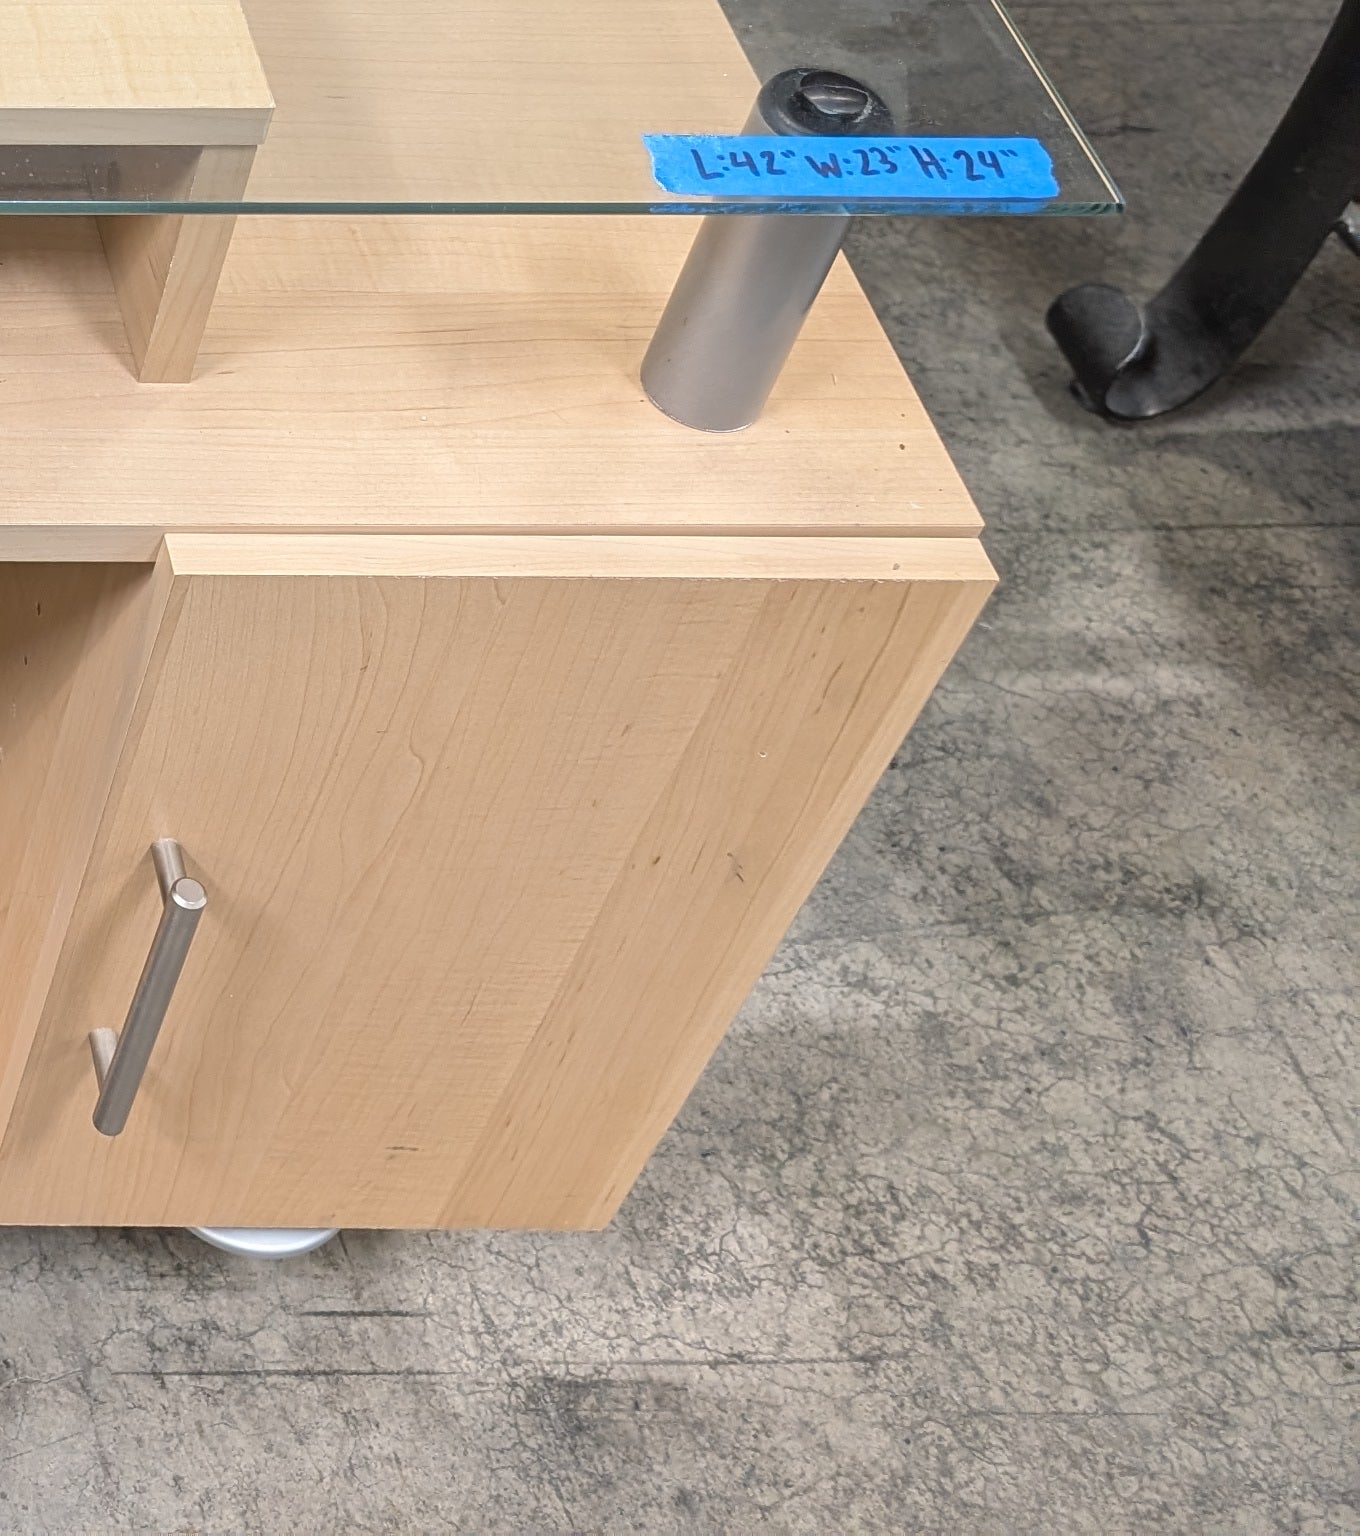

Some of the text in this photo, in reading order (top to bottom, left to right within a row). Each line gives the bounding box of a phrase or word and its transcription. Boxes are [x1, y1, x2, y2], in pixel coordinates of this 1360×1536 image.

[690, 144, 1019, 182] L:42" W:23" H:24"
